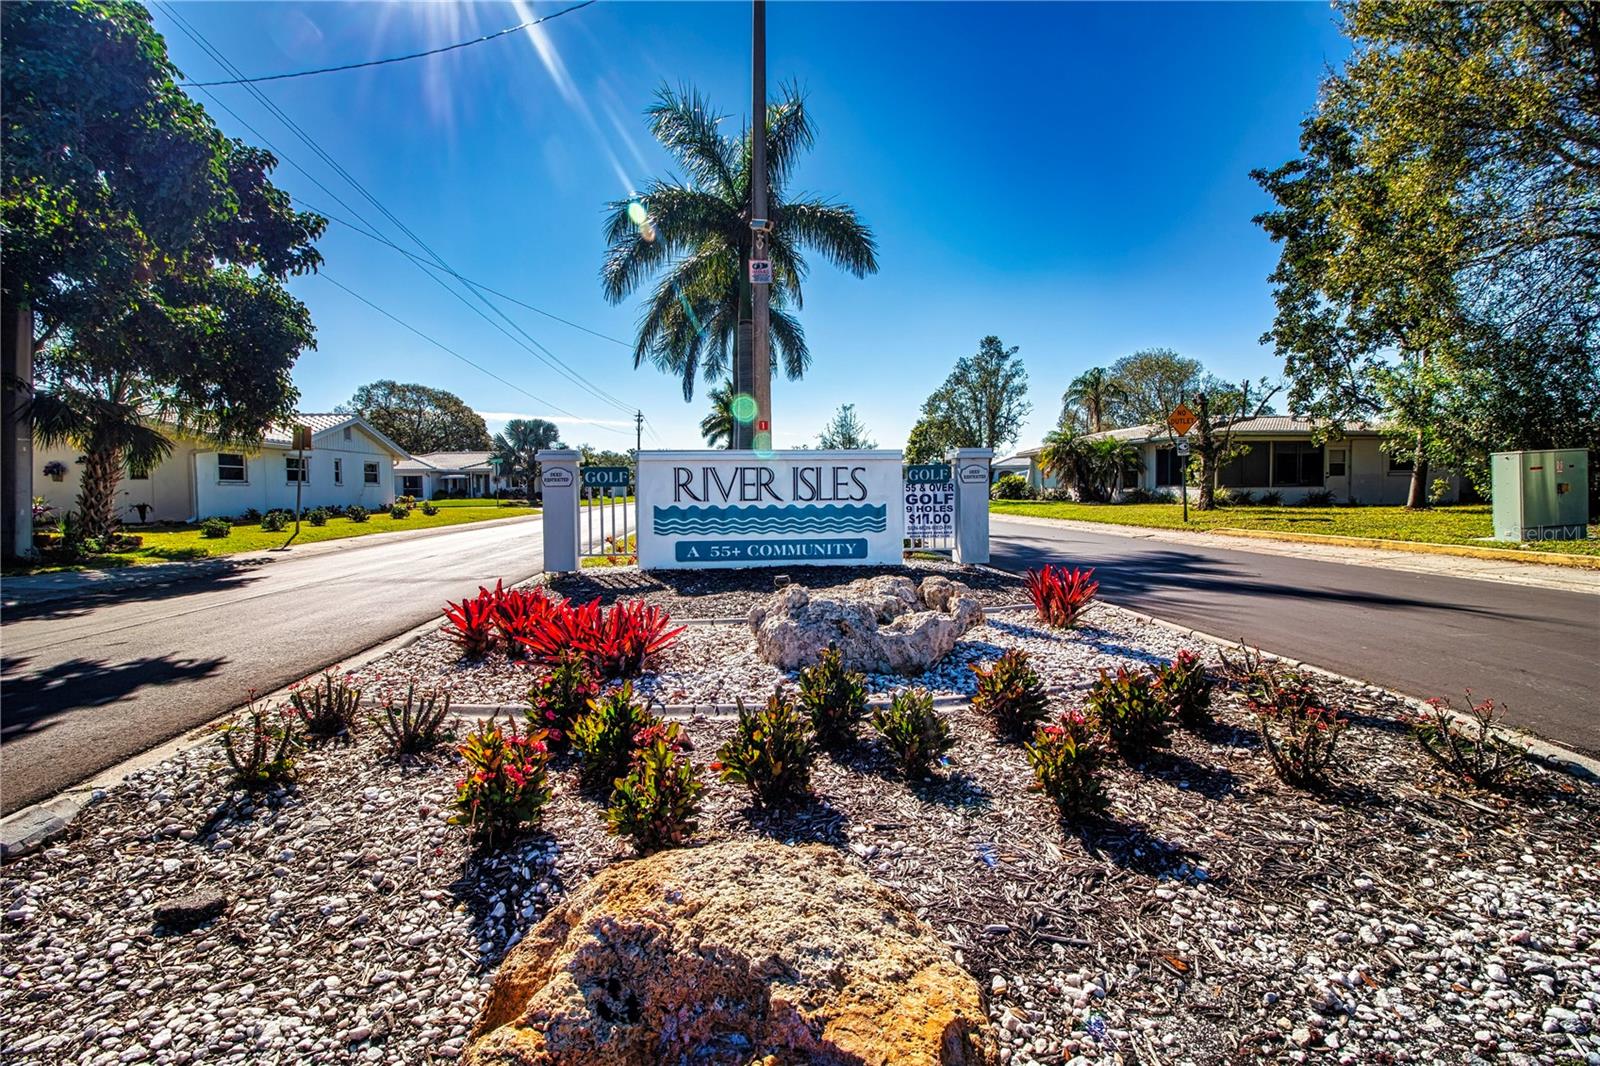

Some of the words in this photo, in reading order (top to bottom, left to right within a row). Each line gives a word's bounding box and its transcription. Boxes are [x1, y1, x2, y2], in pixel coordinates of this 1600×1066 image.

[761, 421, 766, 430] 1
[584, 471, 628, 484] GOLF
[908, 469, 949, 481] GOLF
[673, 467, 784, 502] RIVER
[792, 466, 868, 501] ISLES
[905, 484, 916, 492] 55
[919, 483, 926, 492] &
[929, 483, 954, 492] OVER
[905, 493, 954, 505] GOLF
[906, 505, 912, 513] 9
[916, 505, 954, 513] HOLES
[687, 547, 700, 558] A
[710, 546, 741, 557] 55+
[747, 543, 857, 557] COMMUNITY
